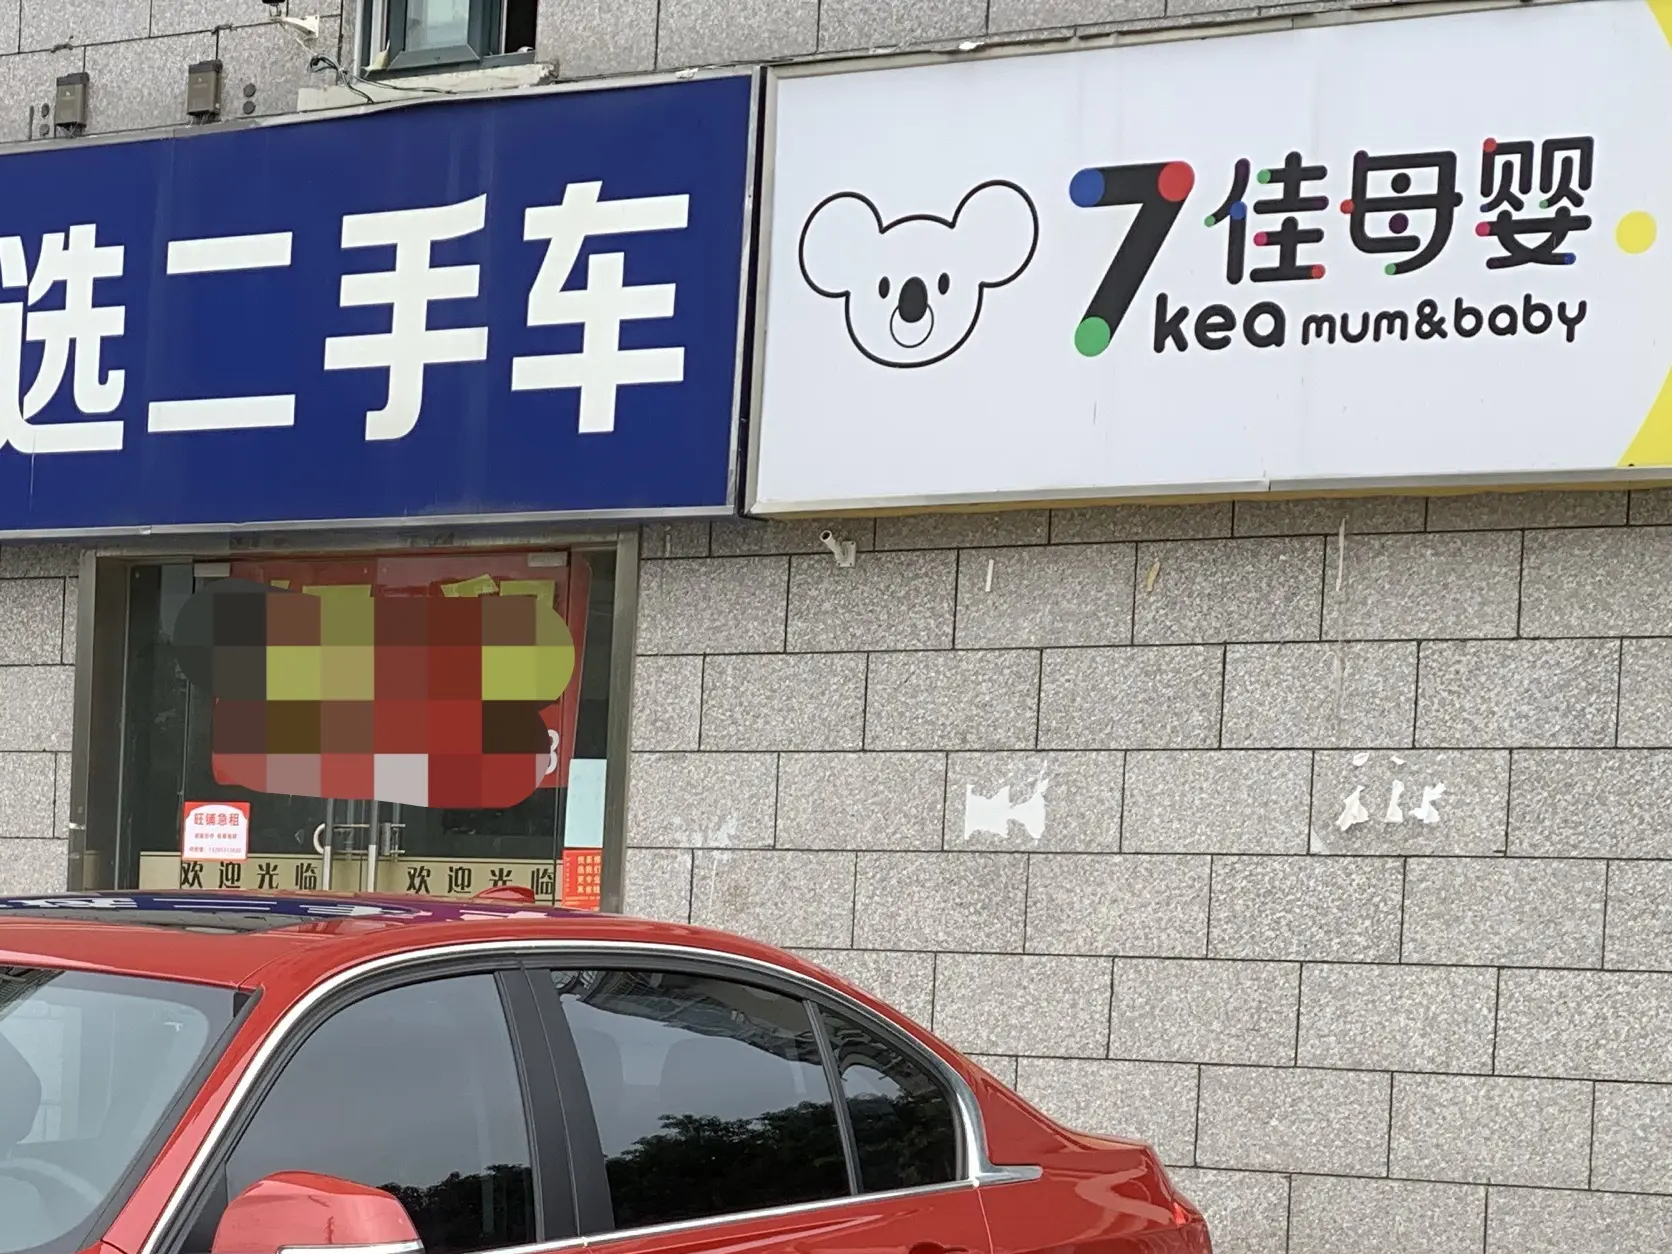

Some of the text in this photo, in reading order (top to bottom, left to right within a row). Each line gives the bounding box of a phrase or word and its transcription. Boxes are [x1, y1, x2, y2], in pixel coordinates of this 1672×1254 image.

[1301, 294, 1588, 346] mum&baby
[181, 860, 319, 890] 欢迎光临
[406, 865, 556, 895] 欢迎光临
